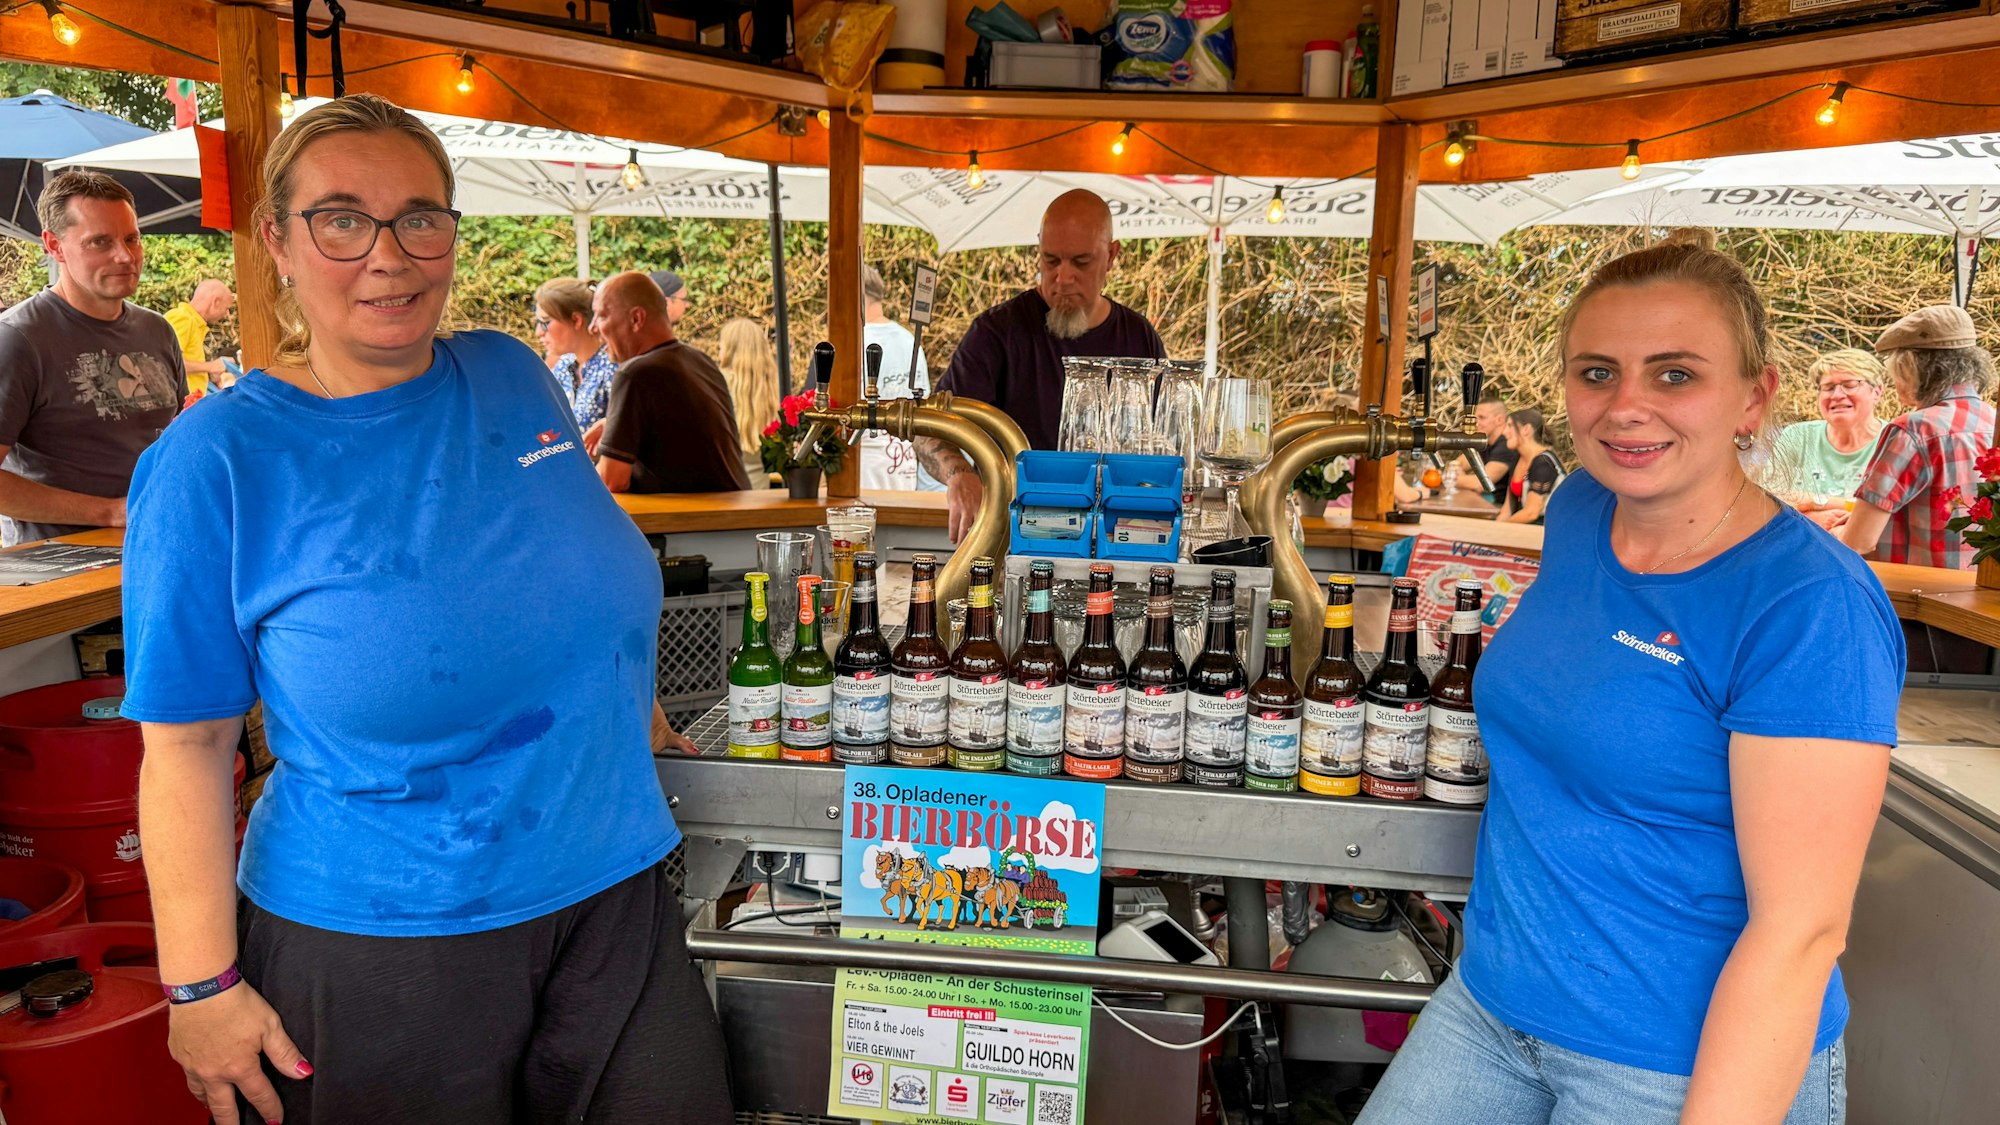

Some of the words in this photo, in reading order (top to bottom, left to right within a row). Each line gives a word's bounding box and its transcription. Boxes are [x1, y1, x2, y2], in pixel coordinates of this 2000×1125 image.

[1602, 8, 1677, 28] BRAUSPEZIALITÄTEN
[1130, 24, 1157, 34] Zewa
[1612, 629, 1685, 666] Störtebeker
[894, 680, 941, 692] Störtebeker
[957, 684, 1004, 696] Störtebeker
[1073, 691, 1121, 704] Störtebeker
[1199, 699, 1246, 710] Störtebeker
[1309, 705, 1360, 719] Störtebeker
[1376, 710, 1426, 723] Störtebeker
[1446, 715, 1477, 727] Störte
[1052, 761, 1059, 769] 65
[1171, 768, 1178, 777] 54
[854, 782, 880, 798] 38.
[886, 784, 987, 807] Opladener
[850, 800, 1096, 859] BIERBÖRSE
[22, 836, 34, 844] der
[946, 976, 964, 987] An
[968, 978, 990, 991] der
[994, 981, 1083, 1002] Schusterinsel
[846, 981, 857, 990] Fr.
[867, 984, 881, 993] Sa.
[939, 992, 955, 1001] Uhr
[964, 994, 979, 1004] So.
[989, 998, 1006, 1008] Mo.
[1066, 1008, 1082, 1016] Uhr
[931, 1008, 964, 1018] Eintritt
[966, 1010, 982, 1020] frei
[848, 1018, 871, 1031] Elton
[874, 1021, 880, 1032] &
[883, 1022, 898, 1034] the
[900, 1024, 925, 1037] Joels
[847, 1041, 868, 1054] VIER
[871, 1045, 915, 1060] GEWINNT
[966, 1041, 1024, 1065] GUILDO
[1029, 1049, 1074, 1071] HORN
[980, 1064, 1019, 1074] Orthopädischen
[988, 1093, 1026, 1108] Zipfer
